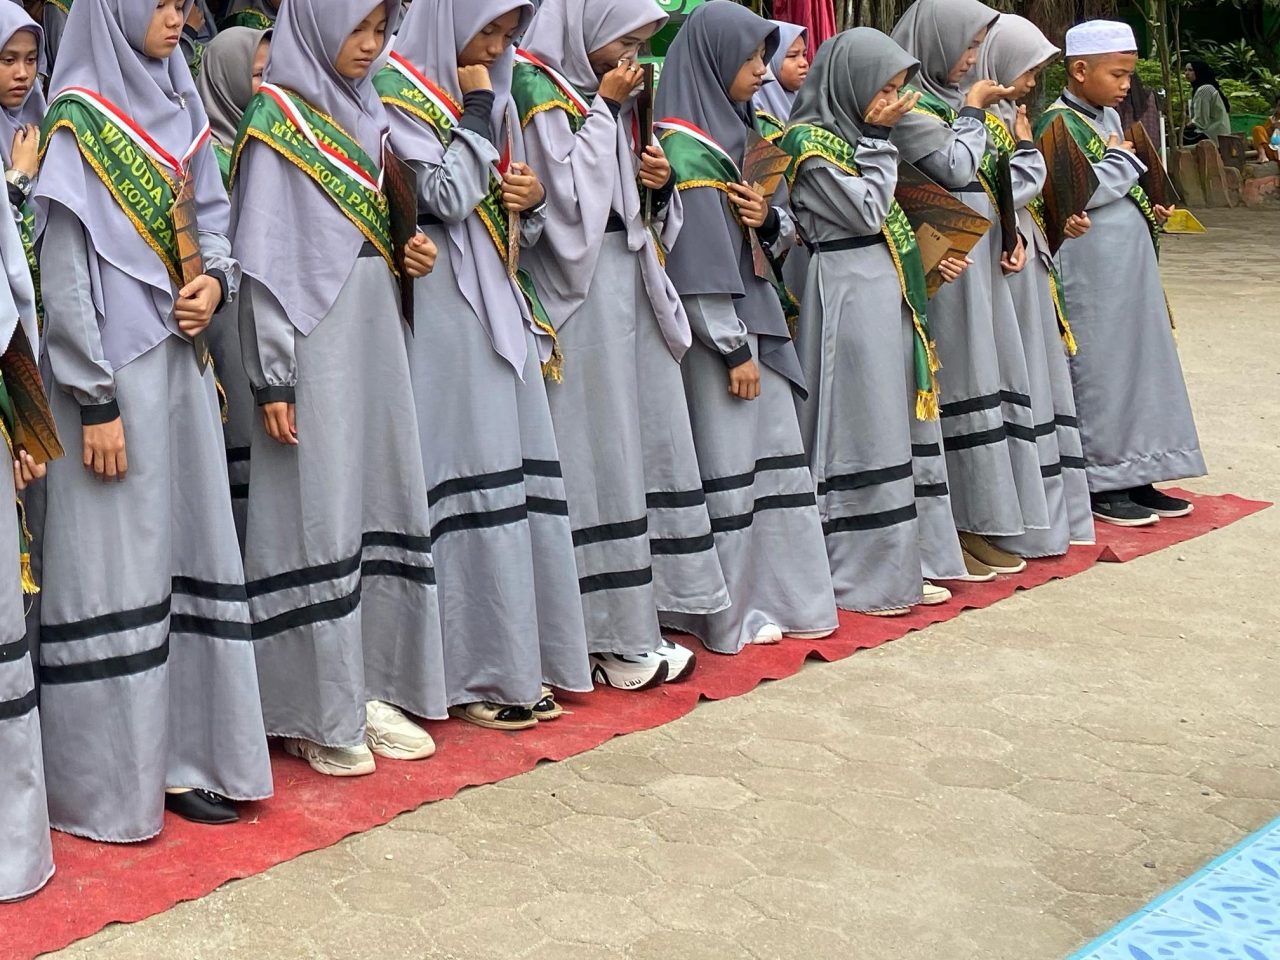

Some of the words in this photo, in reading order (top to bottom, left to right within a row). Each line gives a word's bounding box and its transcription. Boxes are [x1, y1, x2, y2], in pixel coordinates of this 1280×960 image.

[100, 121, 164, 207] WISUDA
[313, 162, 347, 198] KOTA
[118, 179, 154, 221] KOTA
